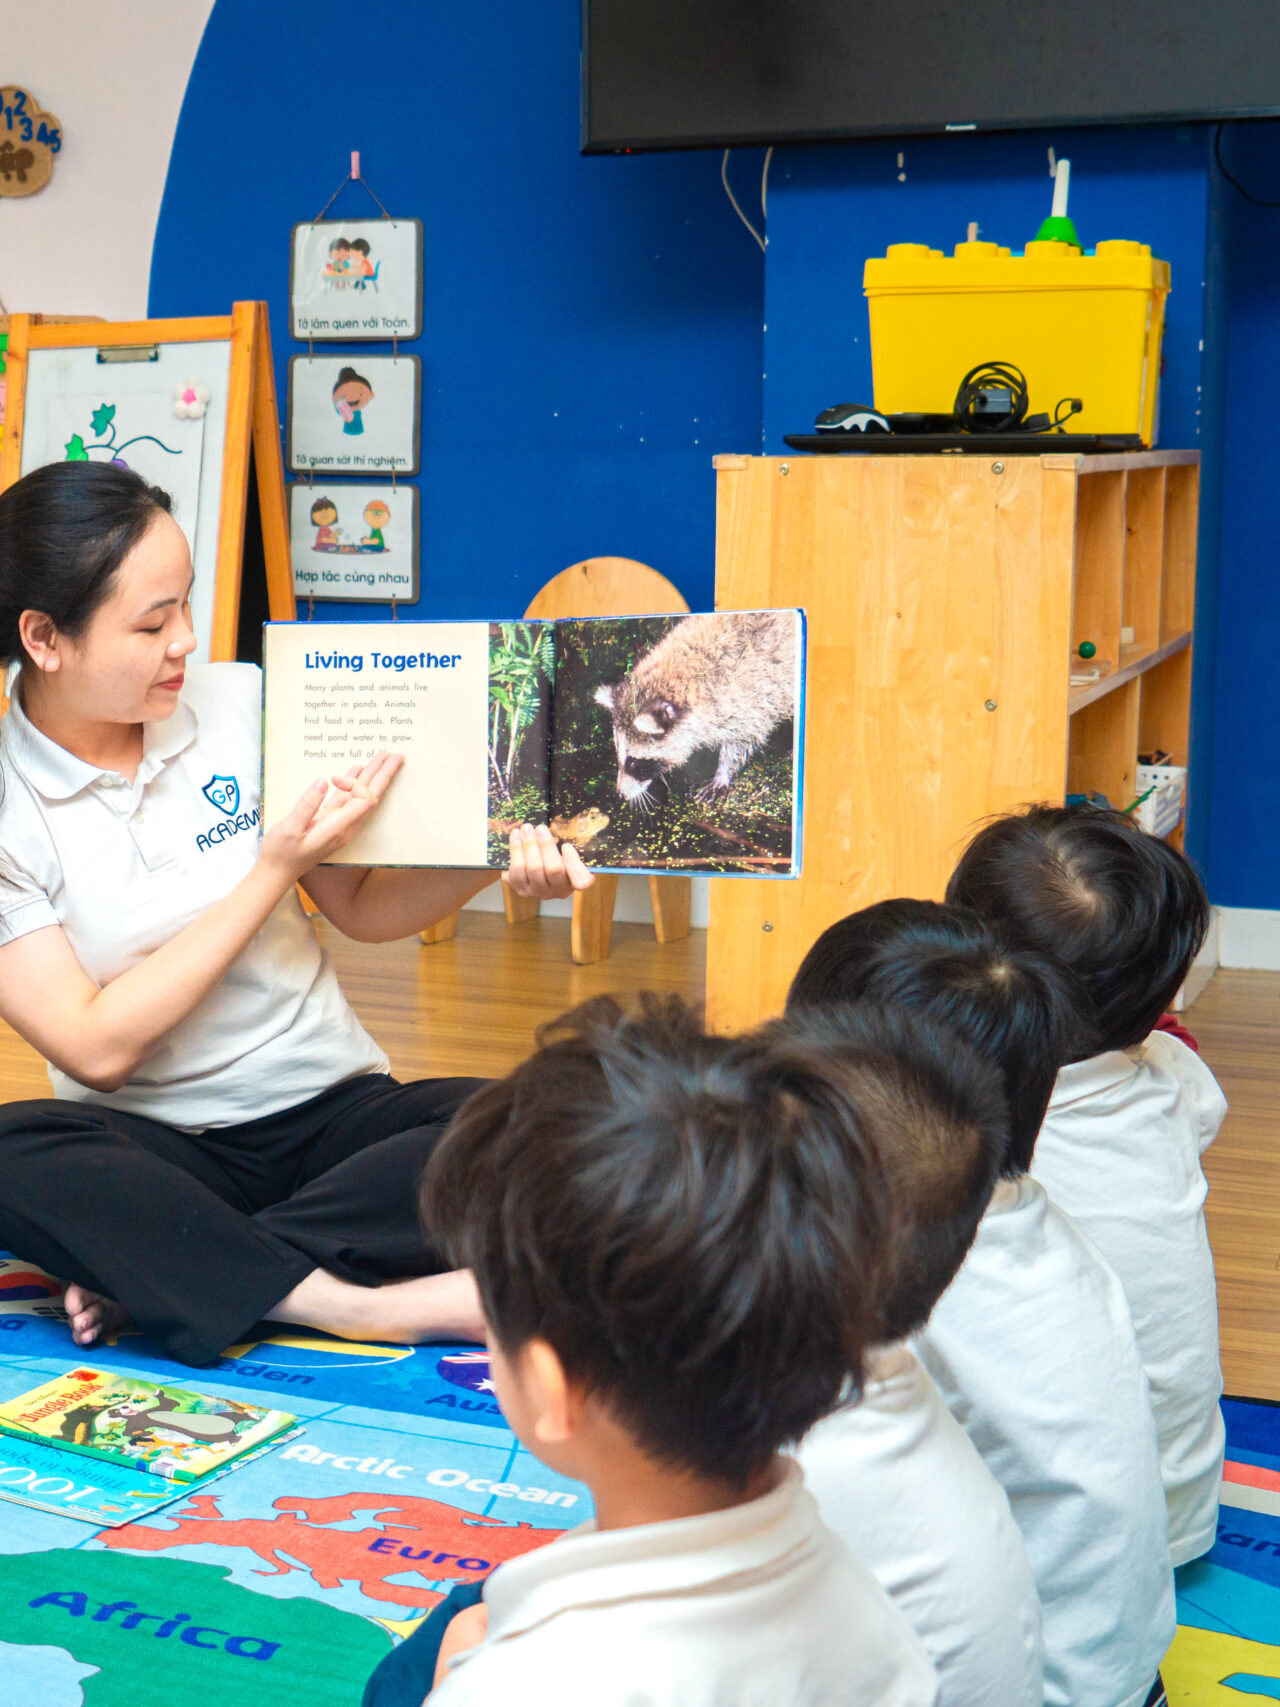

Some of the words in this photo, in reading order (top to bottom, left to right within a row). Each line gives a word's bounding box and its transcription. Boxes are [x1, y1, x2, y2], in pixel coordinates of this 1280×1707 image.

[332, 319, 359, 331] quen
[344, 570, 375, 586] cùng
[379, 572, 409, 584] nhau
[305, 651, 363, 672] Living
[370, 652, 462, 672] Together
[304, 684, 326, 693] Many
[331, 683, 354, 692] plants
[359, 683, 374, 691] and
[379, 683, 410, 691] animals
[414, 683, 428, 691] live
[304, 700, 336, 709] together
[341, 700, 348, 708] in
[384, 700, 416, 708] Animals
[305, 716, 320, 725] find
[324, 716, 342, 725] food
[347, 717, 354, 725] in
[359, 716, 384, 726] ponds.
[390, 716, 413, 725] Plants
[304, 733, 323, 741] need
[328, 733, 348, 743] pond
[392, 735, 414, 743] grow.
[304, 749, 327, 758] Ponds
[350, 749, 362, 758] full
[212, 784, 235, 805] GP
[196, 806, 261, 853] ACADEM
[218, 1360, 316, 1385] eden
[35, 1436, 53, 1446] BOOK
[278, 1444, 414, 1479] Arctic
[426, 1468, 579, 1508] Ocean
[367, 1537, 500, 1572] Euro
[28, 1592, 282, 1661] Africa
